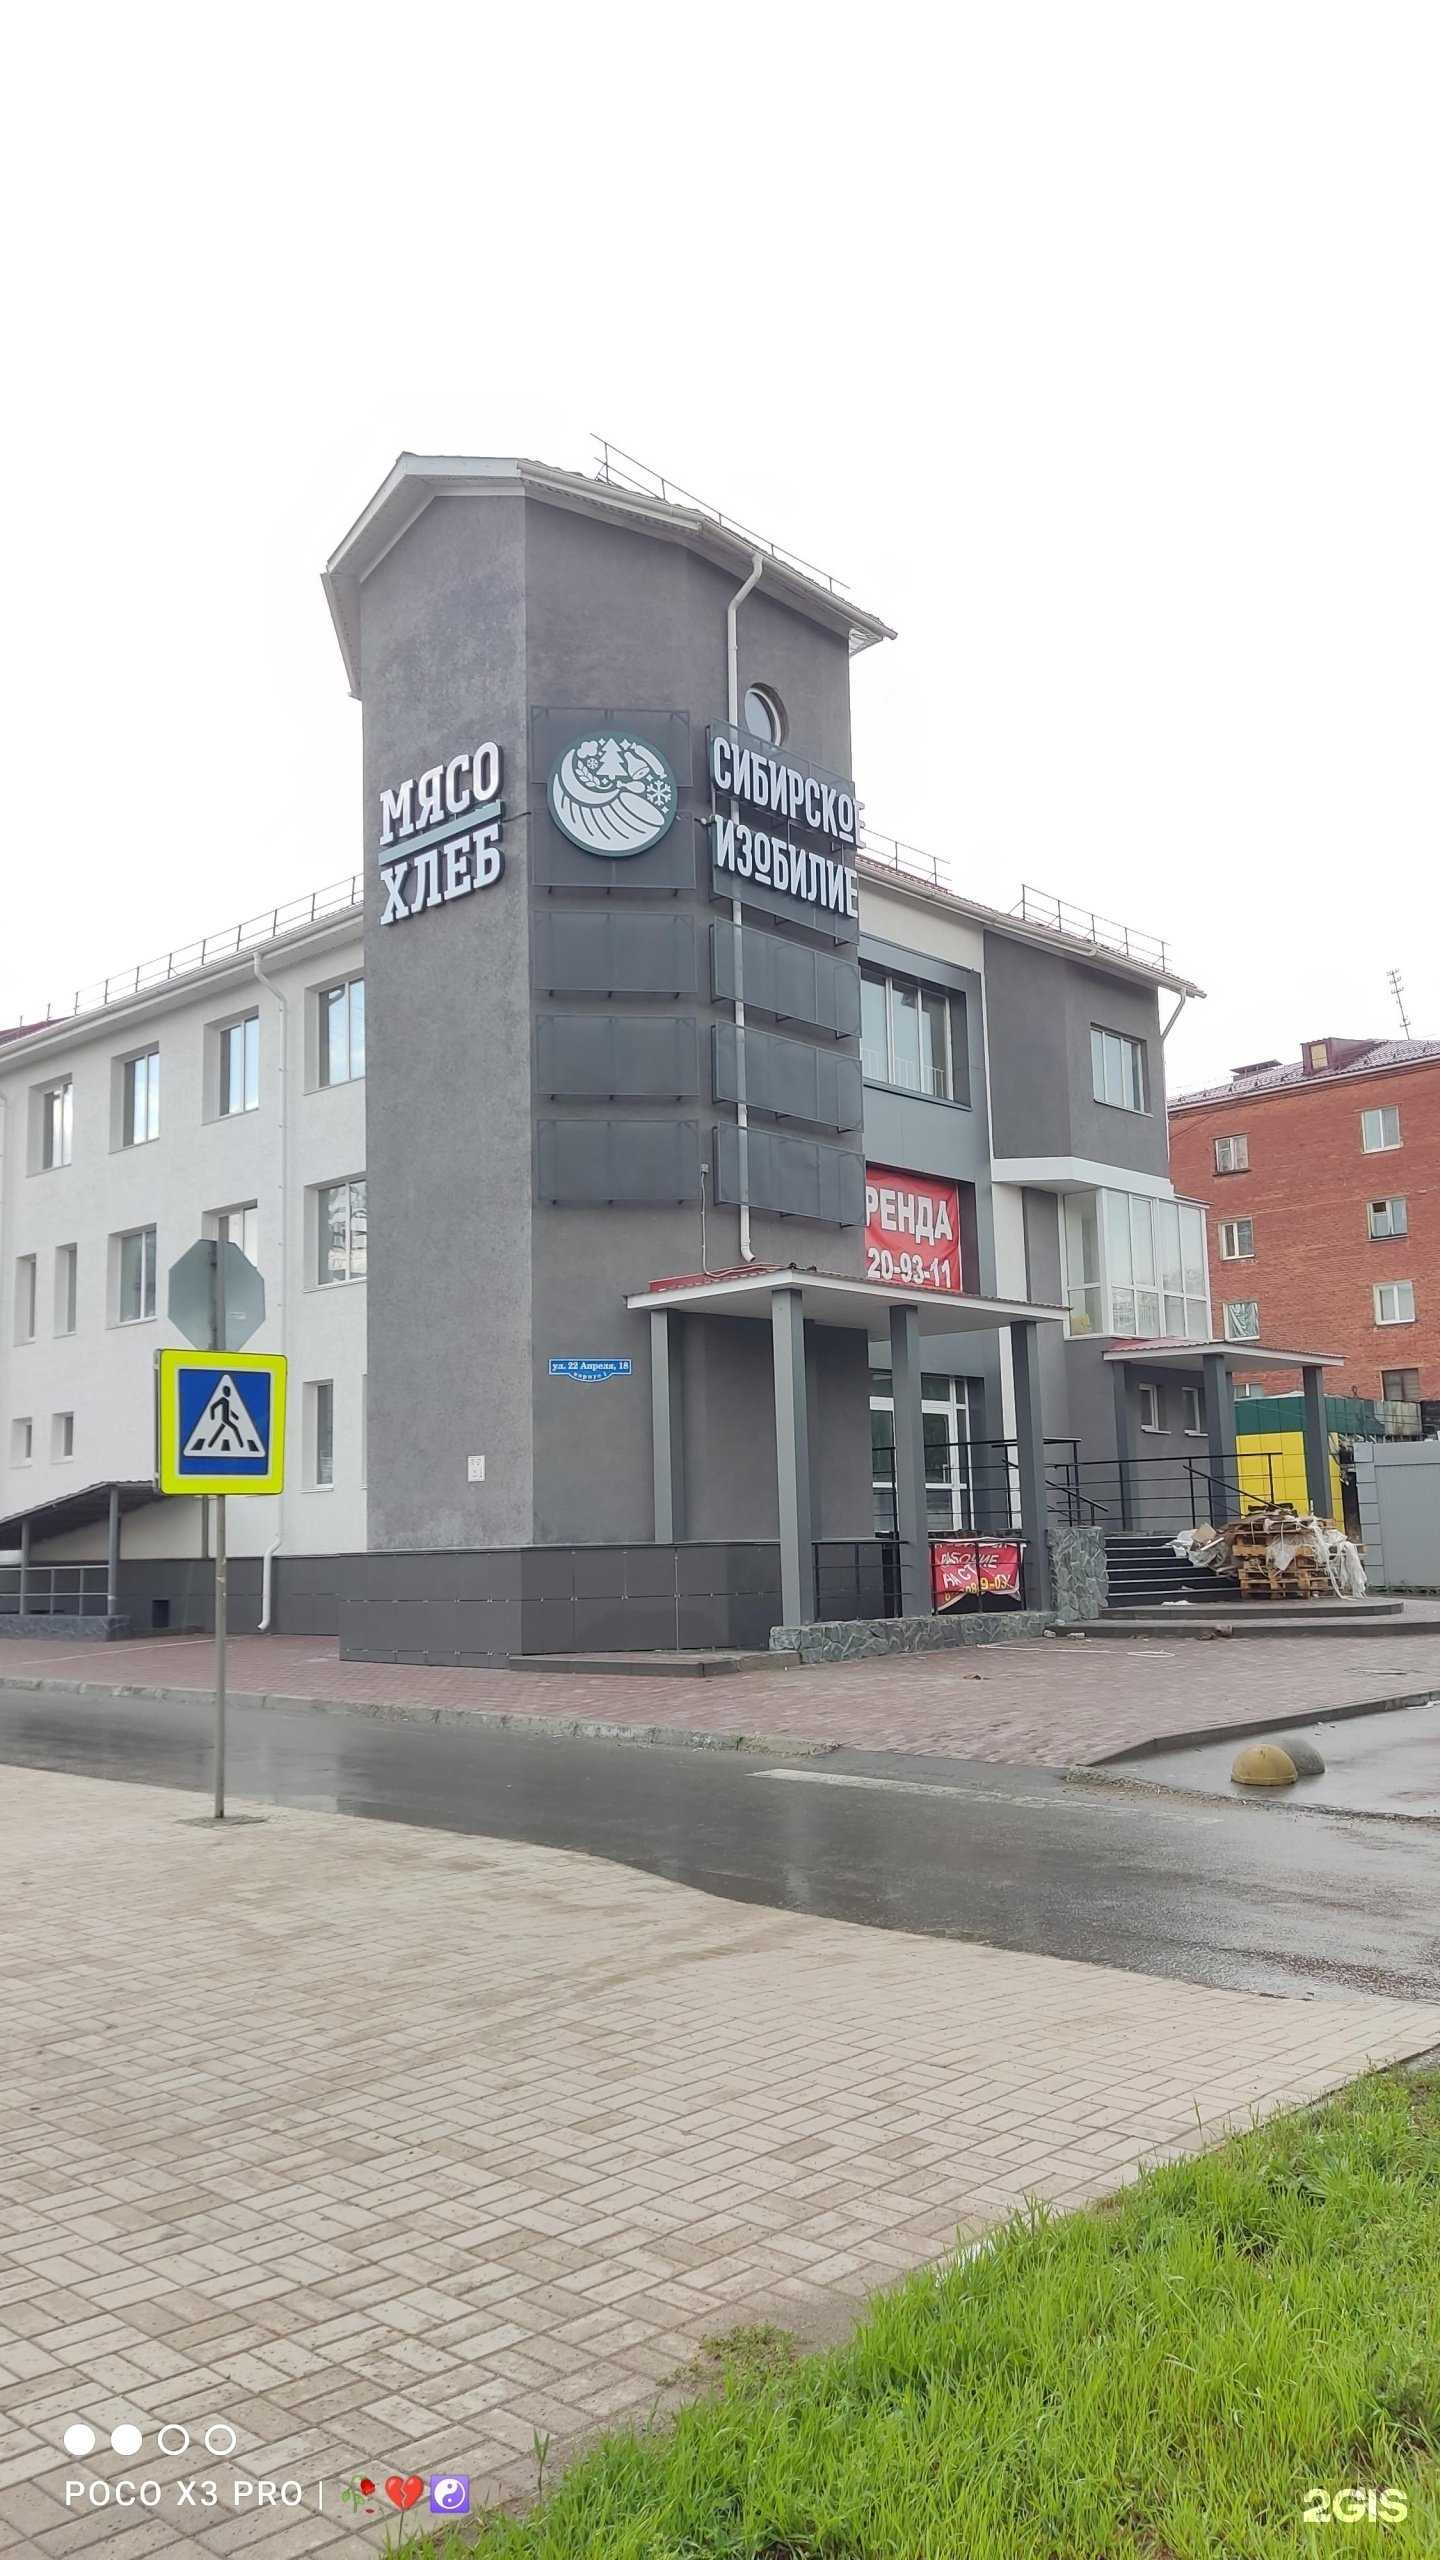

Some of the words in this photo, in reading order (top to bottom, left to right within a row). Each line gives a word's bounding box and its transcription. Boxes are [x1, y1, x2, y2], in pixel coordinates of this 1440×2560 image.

[379, 741, 502, 847] МЯСО
[712, 735, 866, 849] СИБИРСКОЕ
[379, 822, 504, 926] ХЛЕБ
[715, 814, 858, 919] ИЗОБИЛИЕ
[866, 1186, 953, 1246] РЕНДА
[568, 1362, 578, 1370] 22
[619, 1362, 629, 1370] 18
